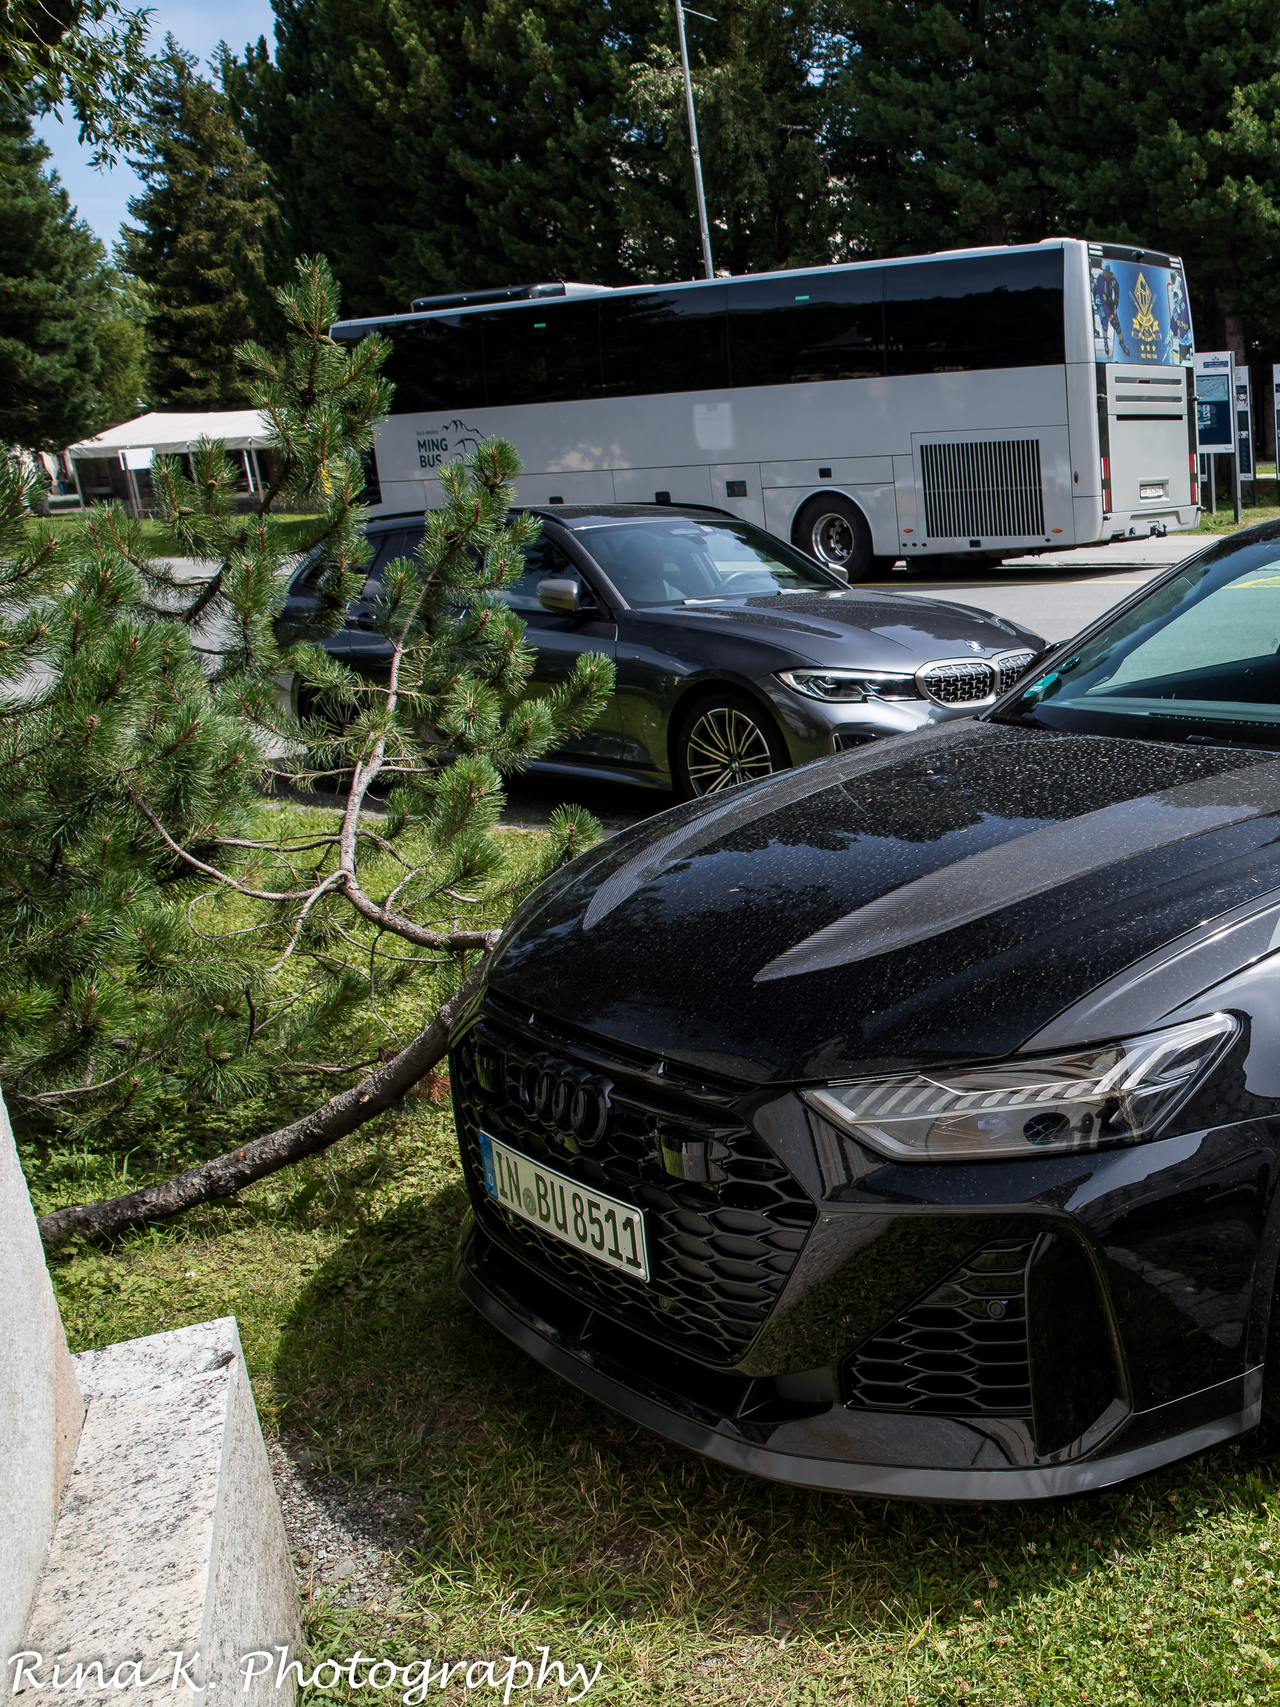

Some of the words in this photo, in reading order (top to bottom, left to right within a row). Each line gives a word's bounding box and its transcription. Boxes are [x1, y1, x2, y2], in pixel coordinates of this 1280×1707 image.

[417, 438, 448, 453] MING
[419, 454, 442, 468] BUS
[495, 1150, 523, 1209] IN
[534, 1172, 569, 1235] BU
[572, 1191, 642, 1269] 8511
